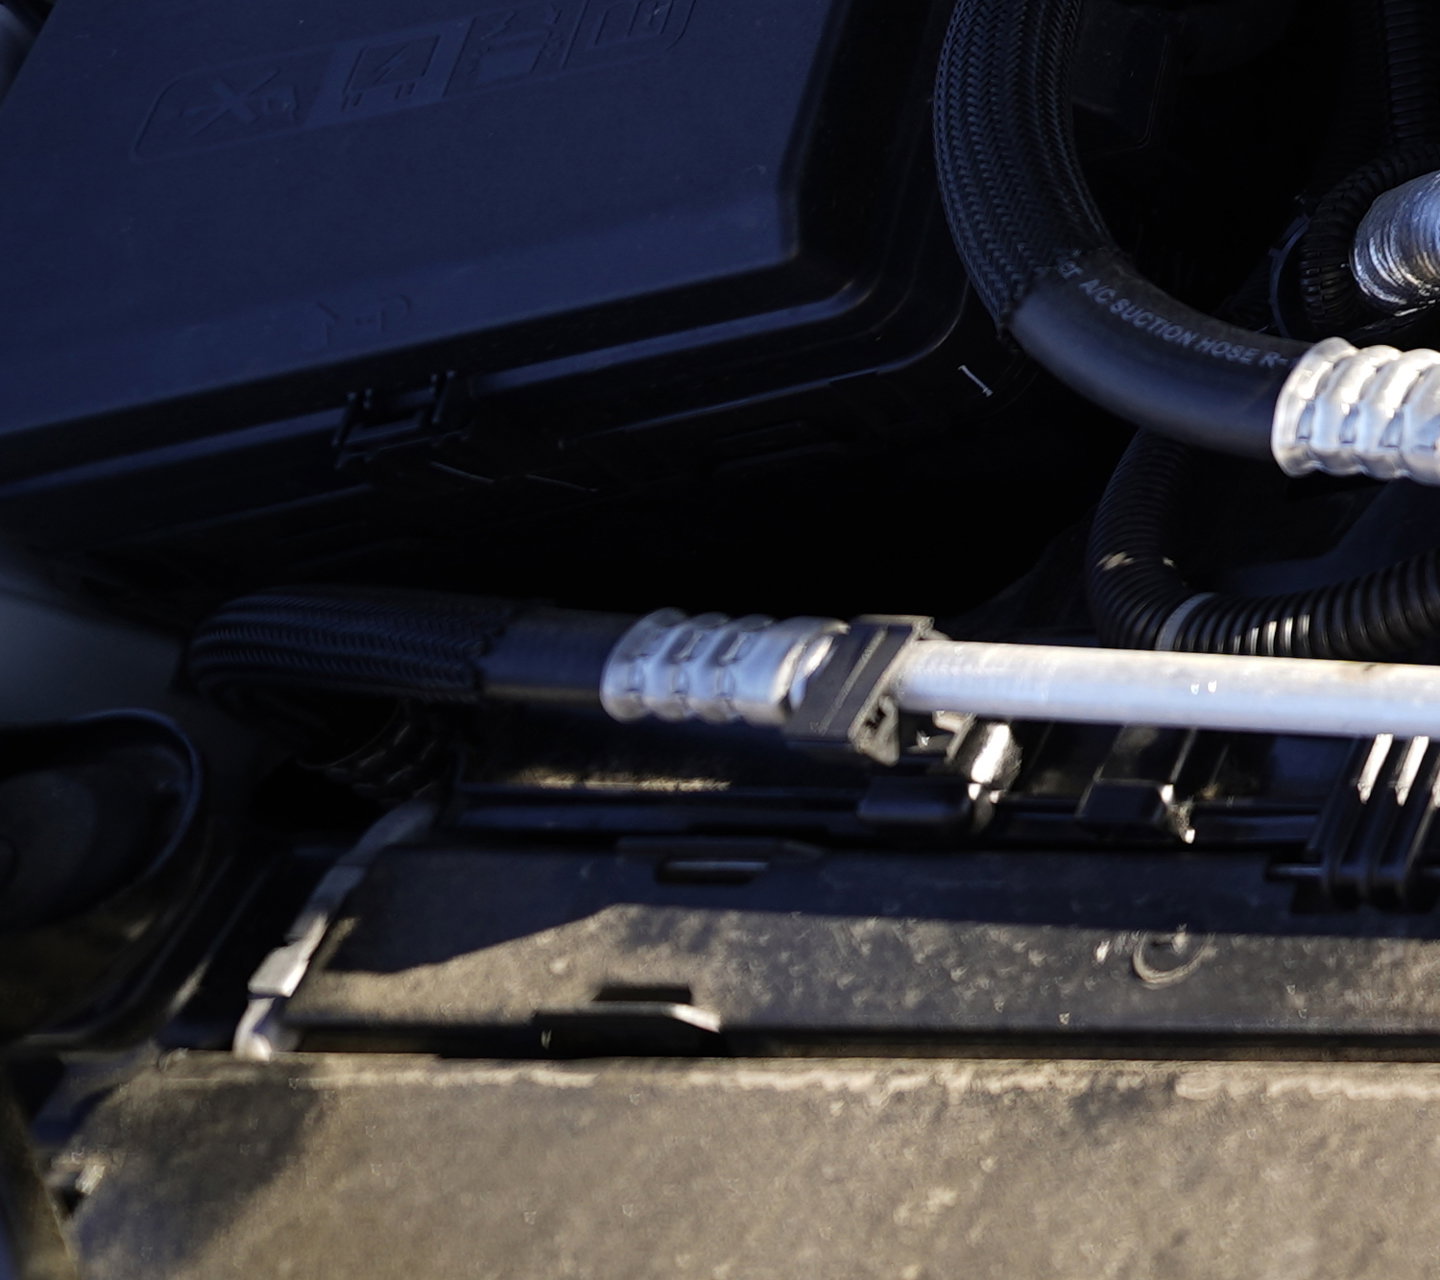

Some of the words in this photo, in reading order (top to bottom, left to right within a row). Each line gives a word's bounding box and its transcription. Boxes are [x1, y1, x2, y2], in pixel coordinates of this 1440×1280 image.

[1079, 278, 1117, 305] A/C
[1109, 297, 1199, 347] SUCTION
[1194, 337, 1261, 366] HOSE
